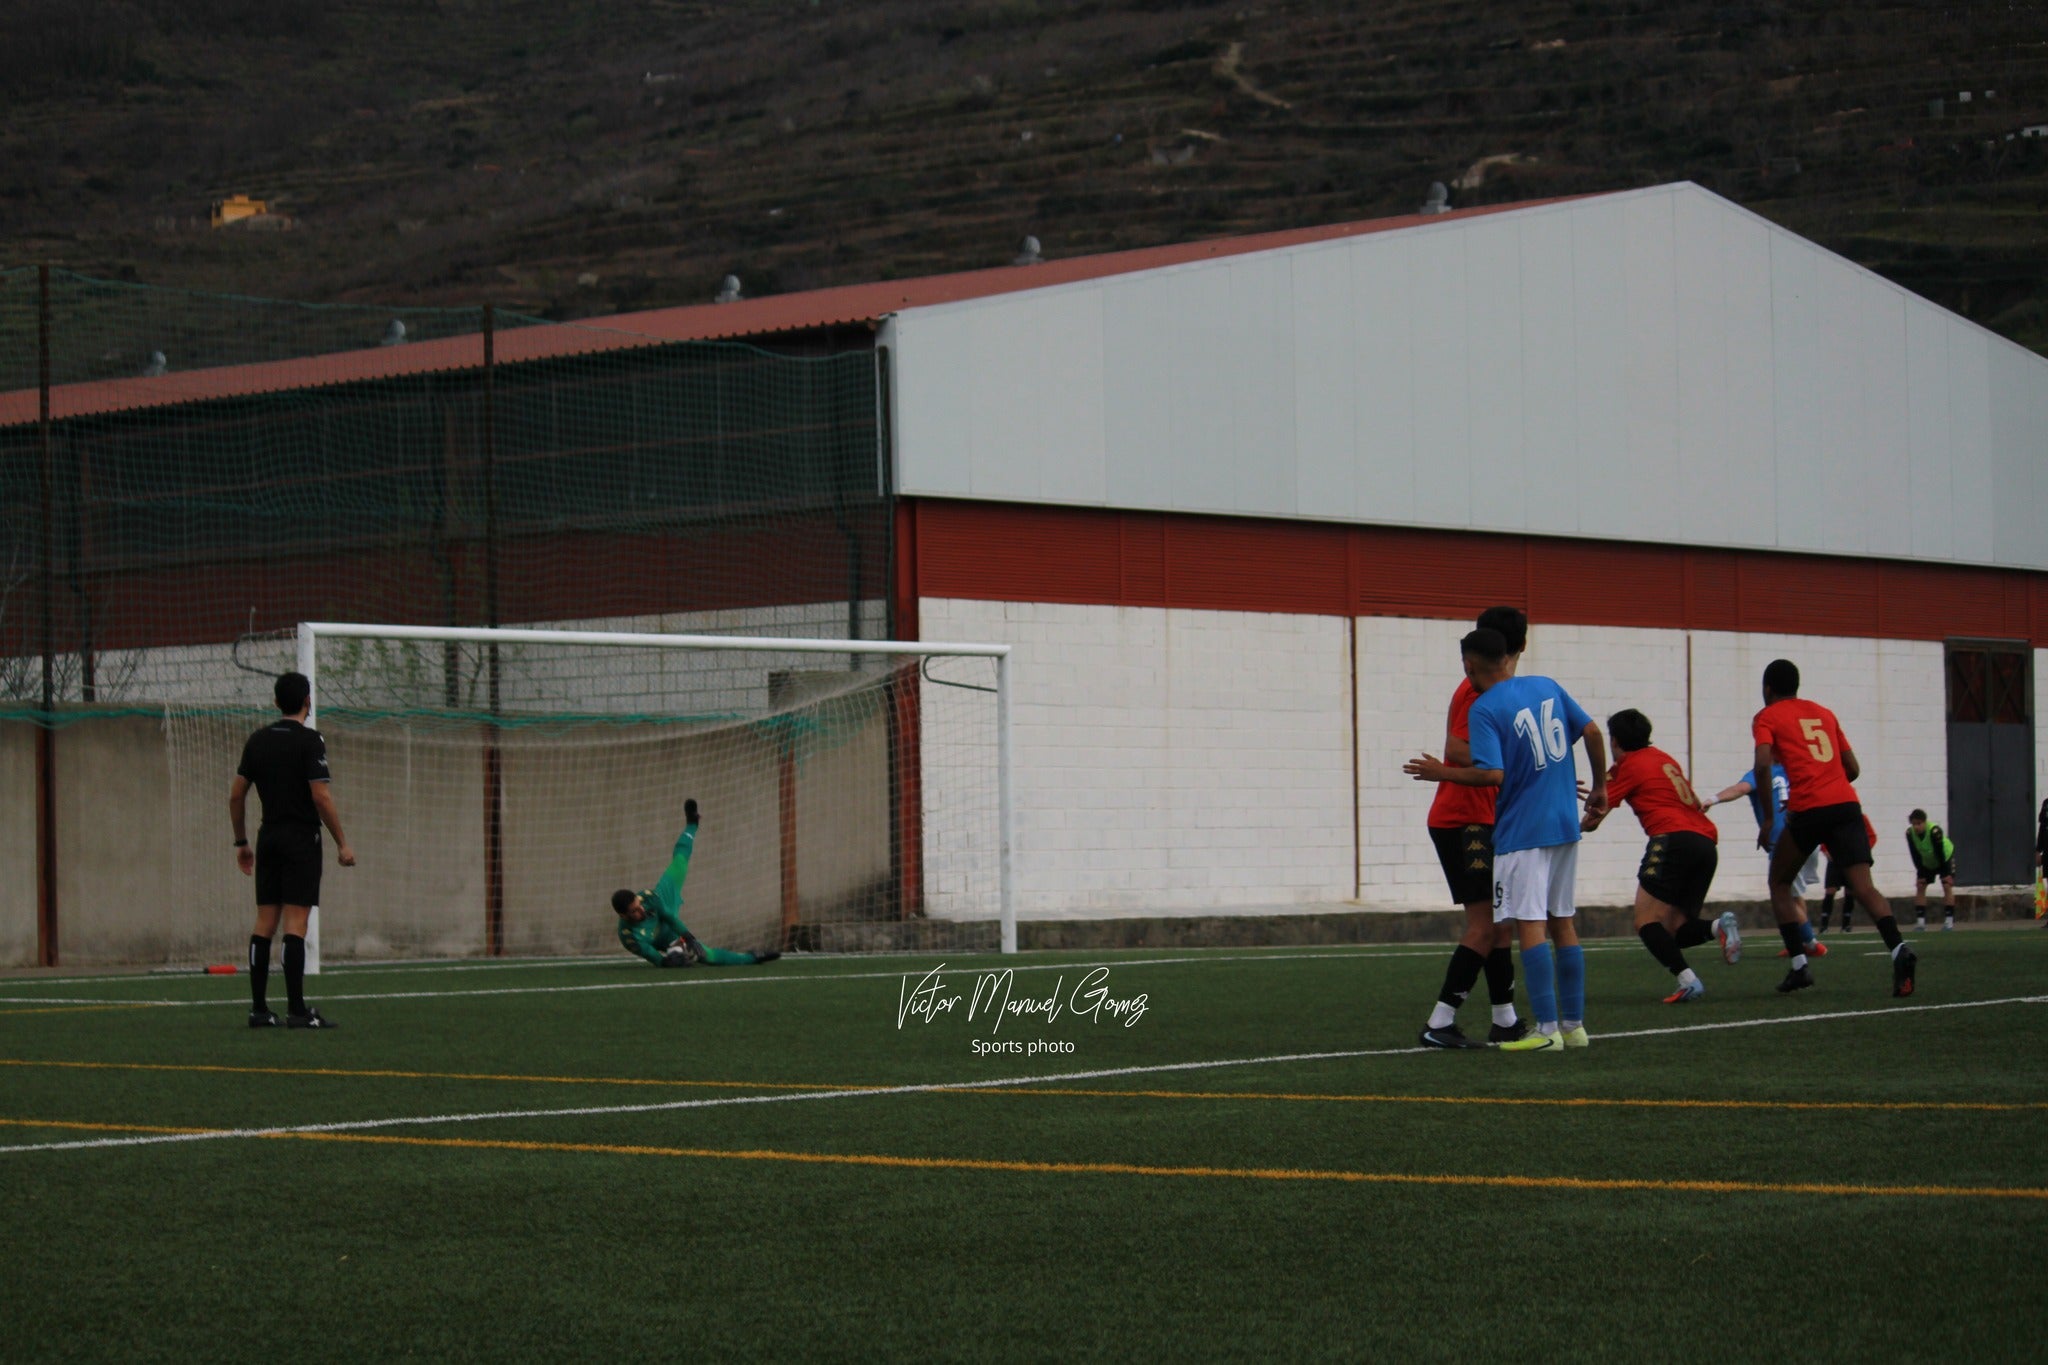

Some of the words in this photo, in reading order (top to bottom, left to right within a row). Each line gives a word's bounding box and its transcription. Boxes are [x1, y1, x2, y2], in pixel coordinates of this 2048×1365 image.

[1513, 698, 1567, 771] 16
[1798, 718, 1835, 763] 5
[1662, 763, 1694, 806] 6
